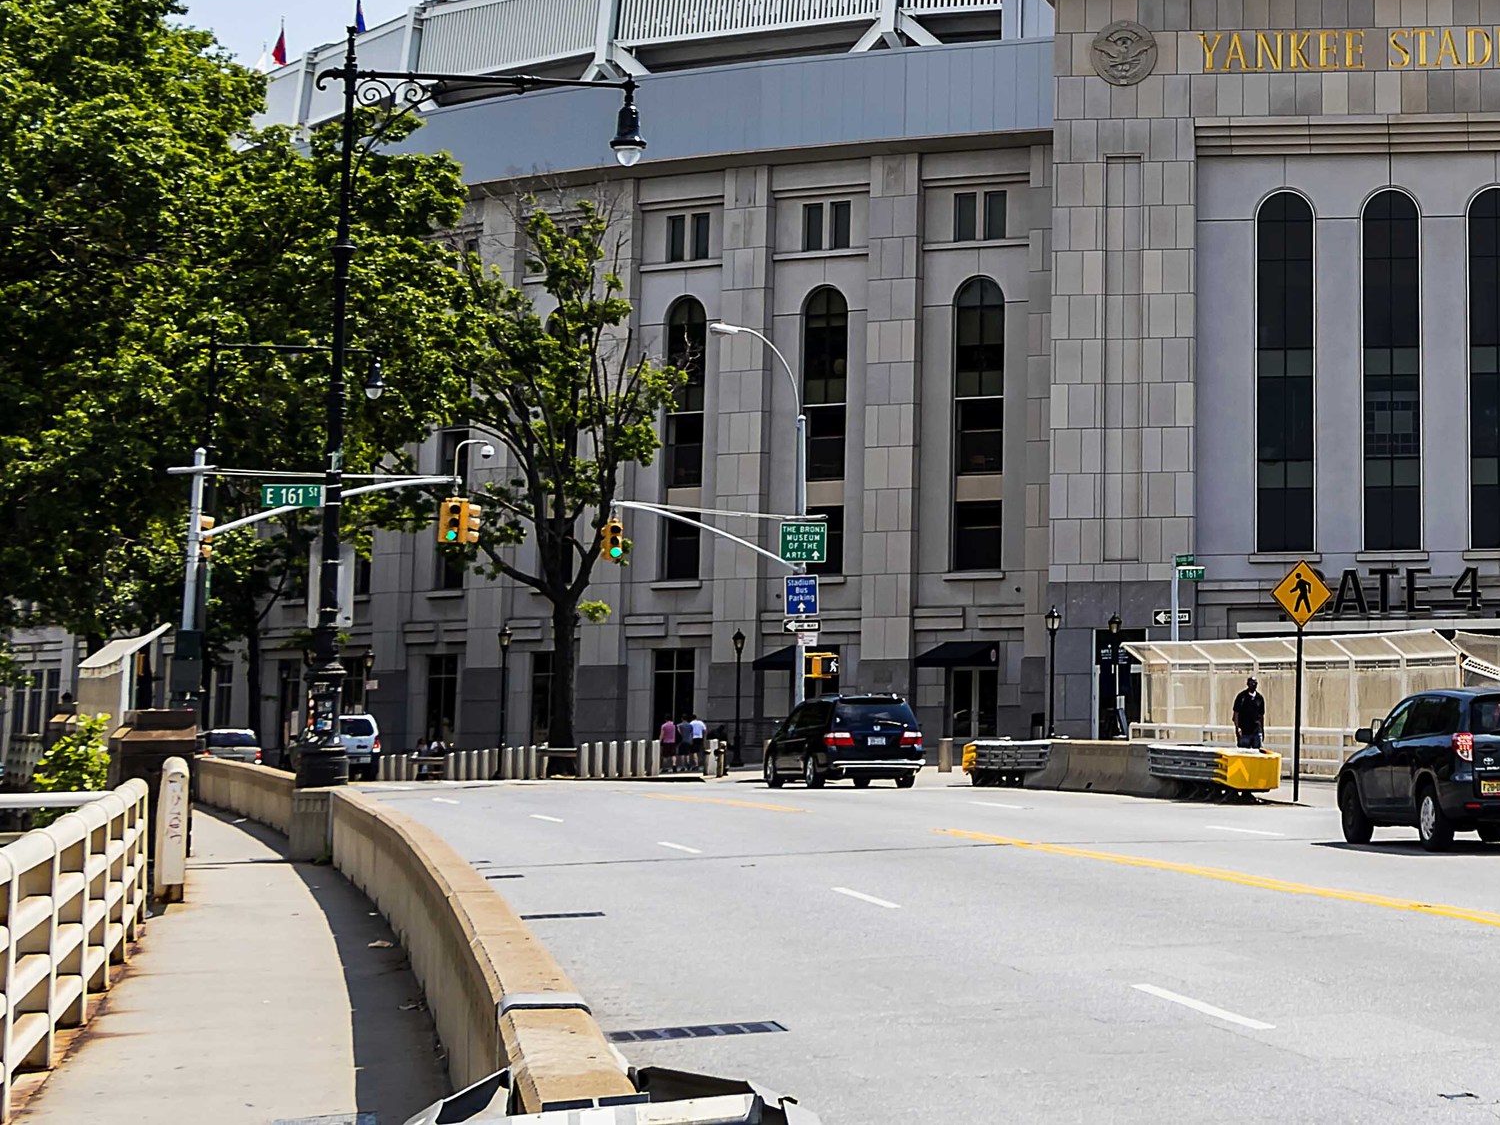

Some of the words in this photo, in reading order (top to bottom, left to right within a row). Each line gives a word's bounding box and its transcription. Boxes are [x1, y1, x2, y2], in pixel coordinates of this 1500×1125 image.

[1199, 30, 1365, 71] YANKEE
[266, 488, 275, 504] E
[280, 487, 304, 504] 161
[308, 486, 318, 497] St
[785, 551, 807, 559] ARTS
[1186, 570, 1197, 579] 161
[787, 579, 816, 587] Stadium
[1313, 567, 1433, 614] ATE
[1452, 566, 1482, 612] 4
[788, 594, 815, 602] Parking
